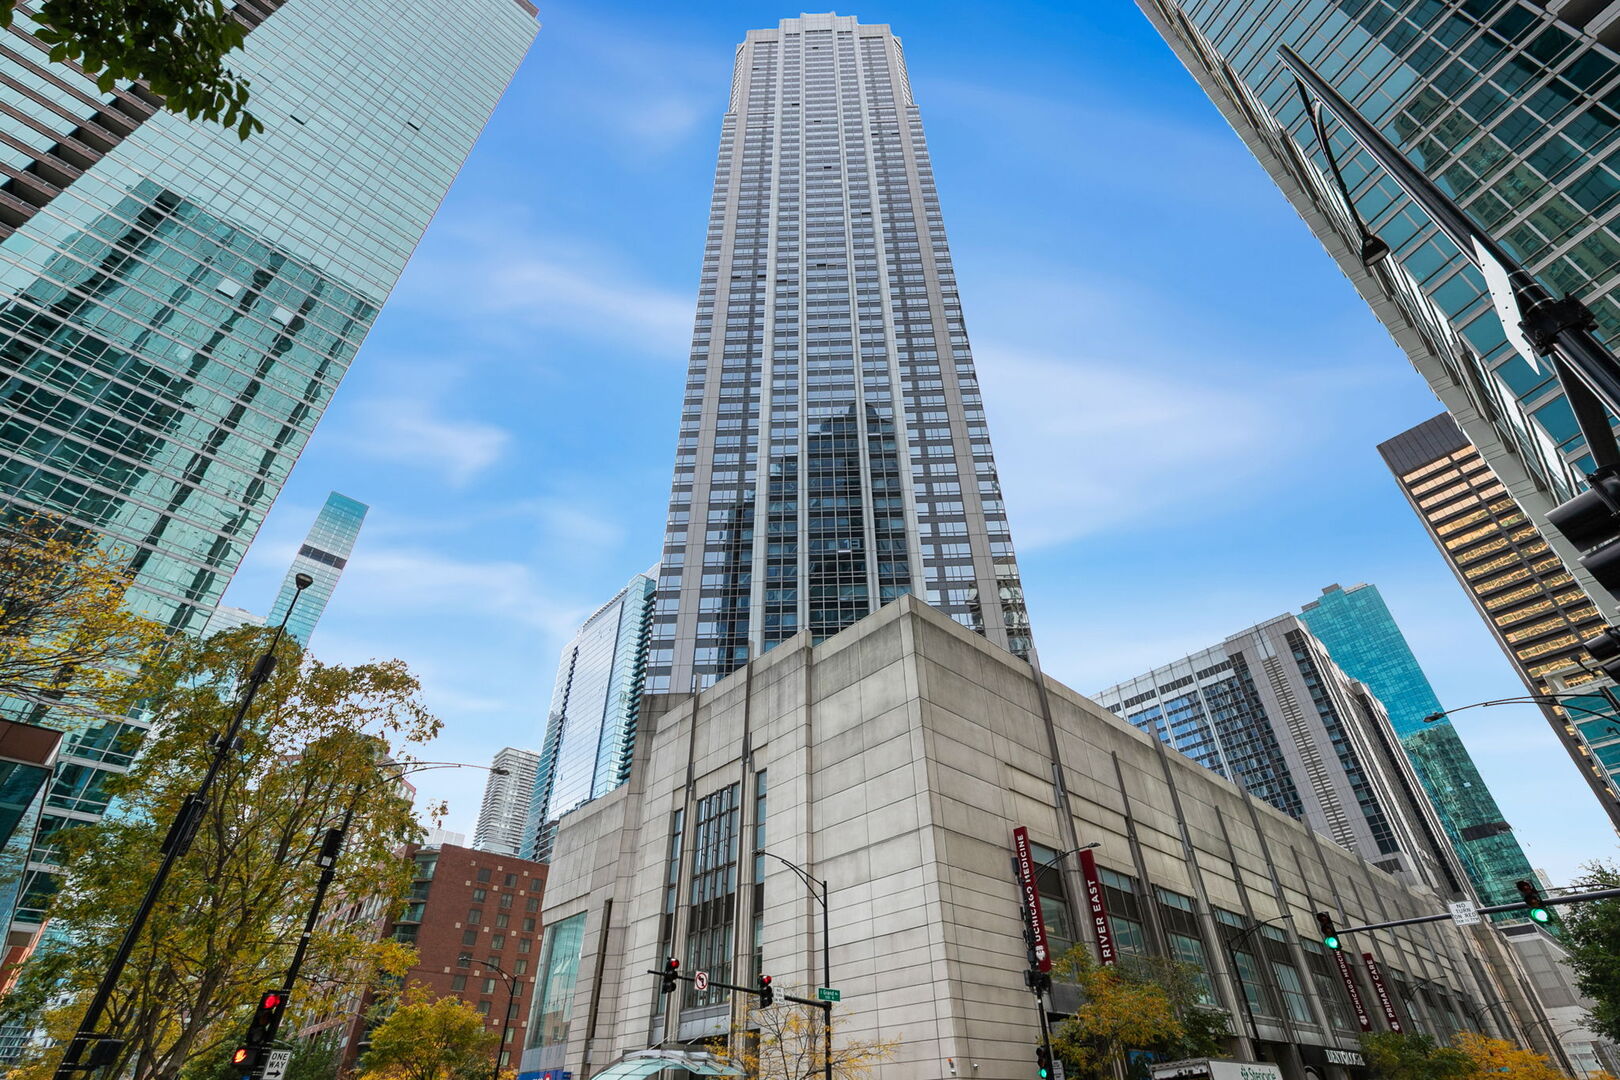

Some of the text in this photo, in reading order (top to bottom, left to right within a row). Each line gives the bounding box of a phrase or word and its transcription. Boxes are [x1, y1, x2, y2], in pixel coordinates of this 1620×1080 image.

[1016, 834, 1042, 942] UCHICAGO MEDICINE
[1087, 879, 1112, 958] RIVER EAST
[1335, 949, 1364, 1014] UCHICAGO MEDICIN
[1366, 959, 1395, 1018] PRIMARY CARE
[269, 1061, 286, 1069] WAY
[271, 1052, 288, 1061] ONE
